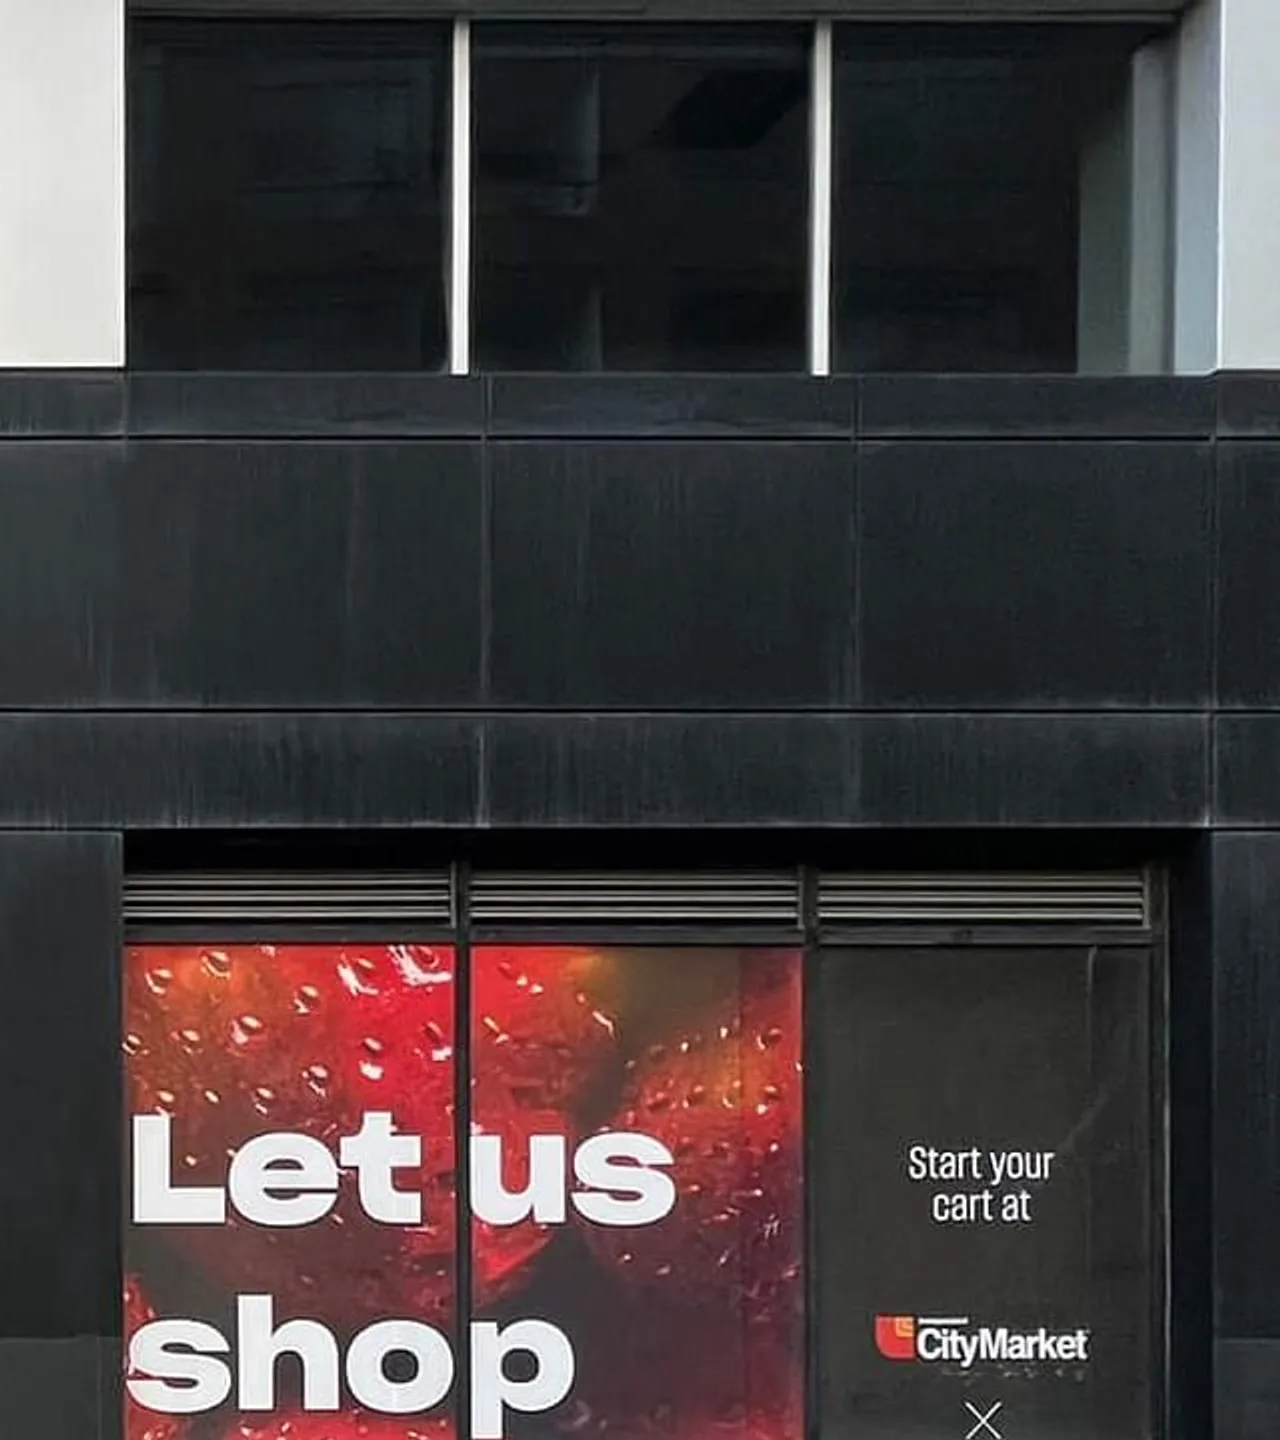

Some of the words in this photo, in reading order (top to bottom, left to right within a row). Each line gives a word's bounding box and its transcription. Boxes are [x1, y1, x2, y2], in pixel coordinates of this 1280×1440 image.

[132, 1112, 422, 1226] Let
[471, 1132, 676, 1226] us
[909, 1146, 982, 1179] Start
[990, 1152, 1055, 1186] your
[933, 1190, 993, 1221] cart
[1001, 1190, 1032, 1221] at
[126, 1294, 576, 1440] shop
[917, 1328, 1088, 1367] CityMarket
